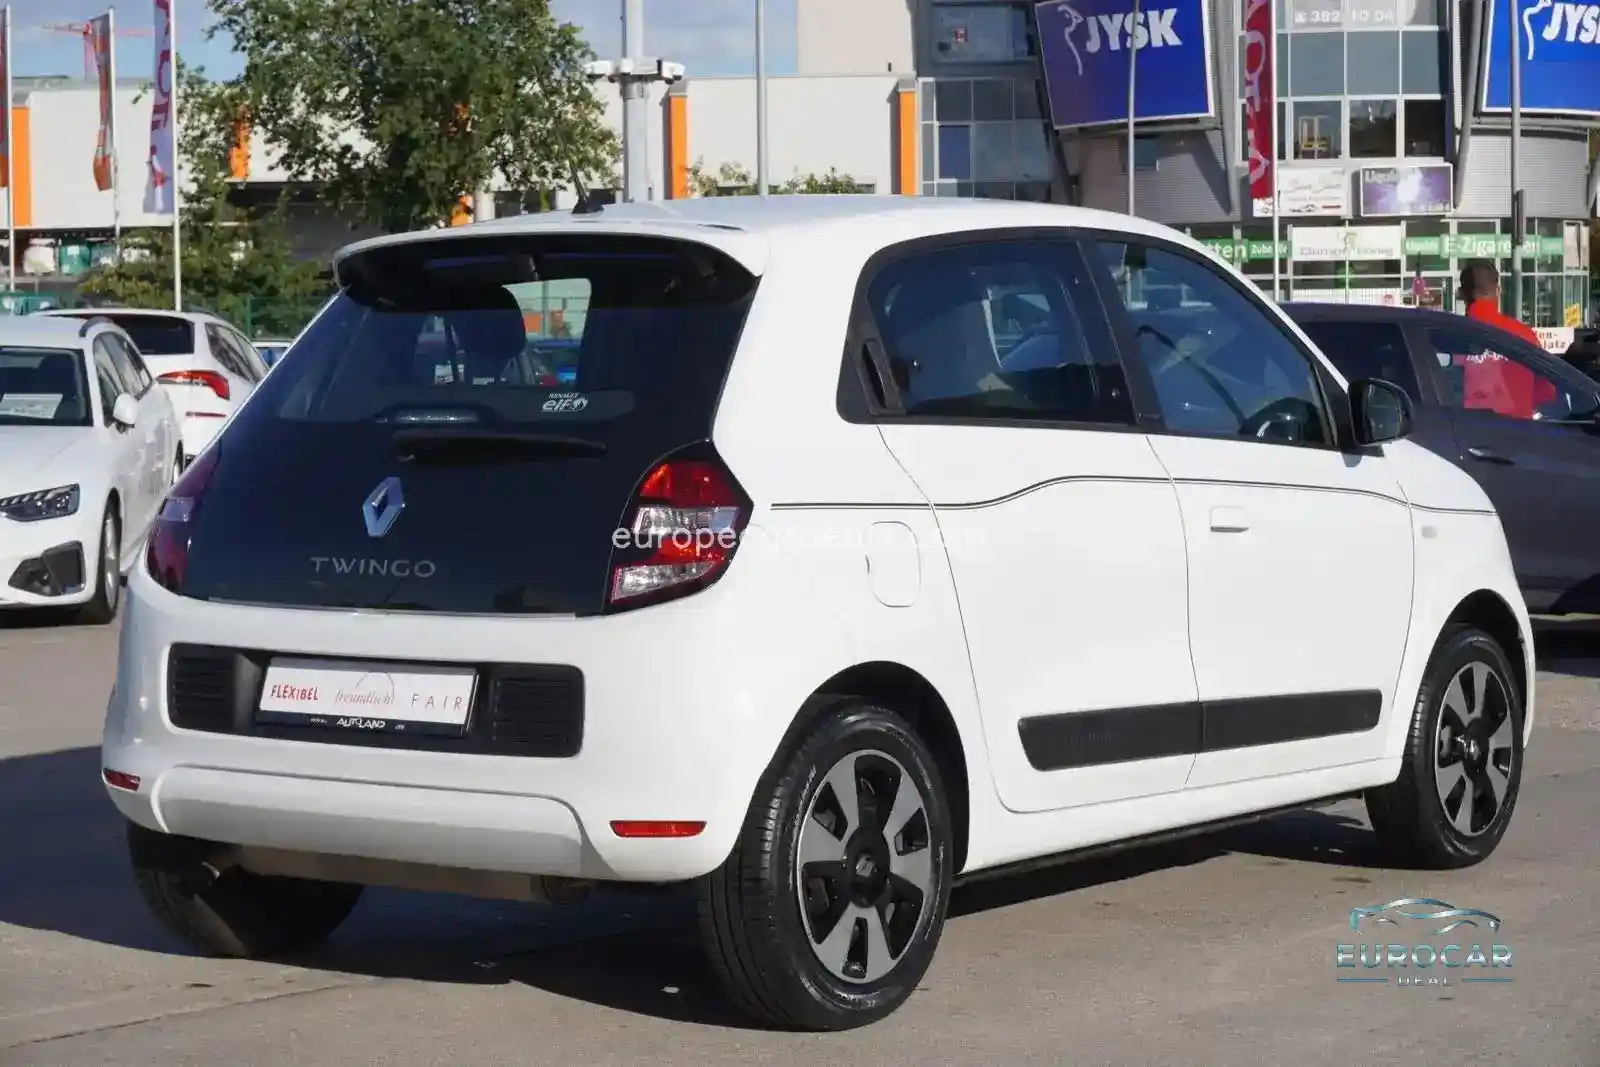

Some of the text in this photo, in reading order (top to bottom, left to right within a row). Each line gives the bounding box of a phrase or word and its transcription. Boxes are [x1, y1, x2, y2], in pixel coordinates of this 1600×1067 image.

[1086, 7, 1182, 53] JYSK
[1541, 2, 1600, 44] JYS
[1250, 243, 1288, 255] Zubeör
[1444, 234, 1541, 257] E-Zigareen
[309, 556, 436, 578] TWINGO
[271, 684, 319, 701] FLEXIBEL
[411, 692, 463, 710] FAIR
